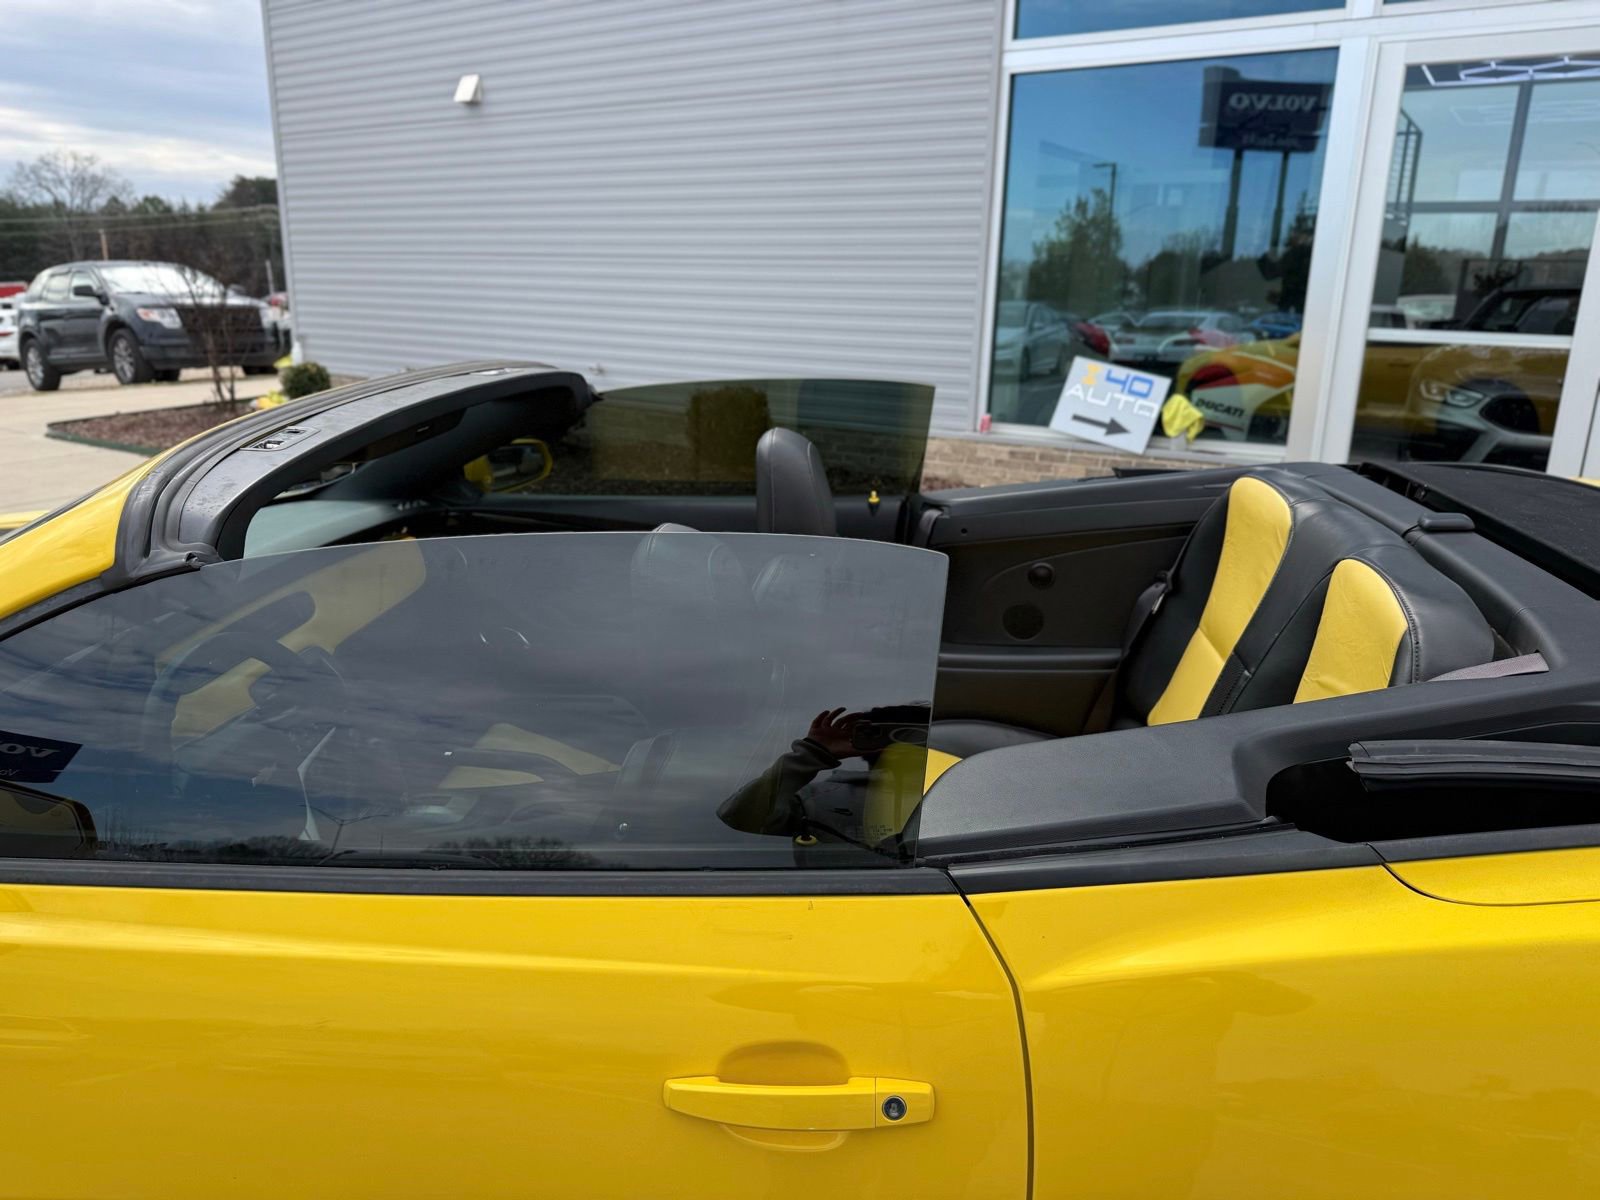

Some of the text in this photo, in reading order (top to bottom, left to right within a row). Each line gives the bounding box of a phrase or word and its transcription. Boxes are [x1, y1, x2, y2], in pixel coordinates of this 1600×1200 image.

[1105, 369, 1154, 398] 40
[1065, 383, 1158, 417] AUTO
[1195, 398, 1245, 418] DUCATI
